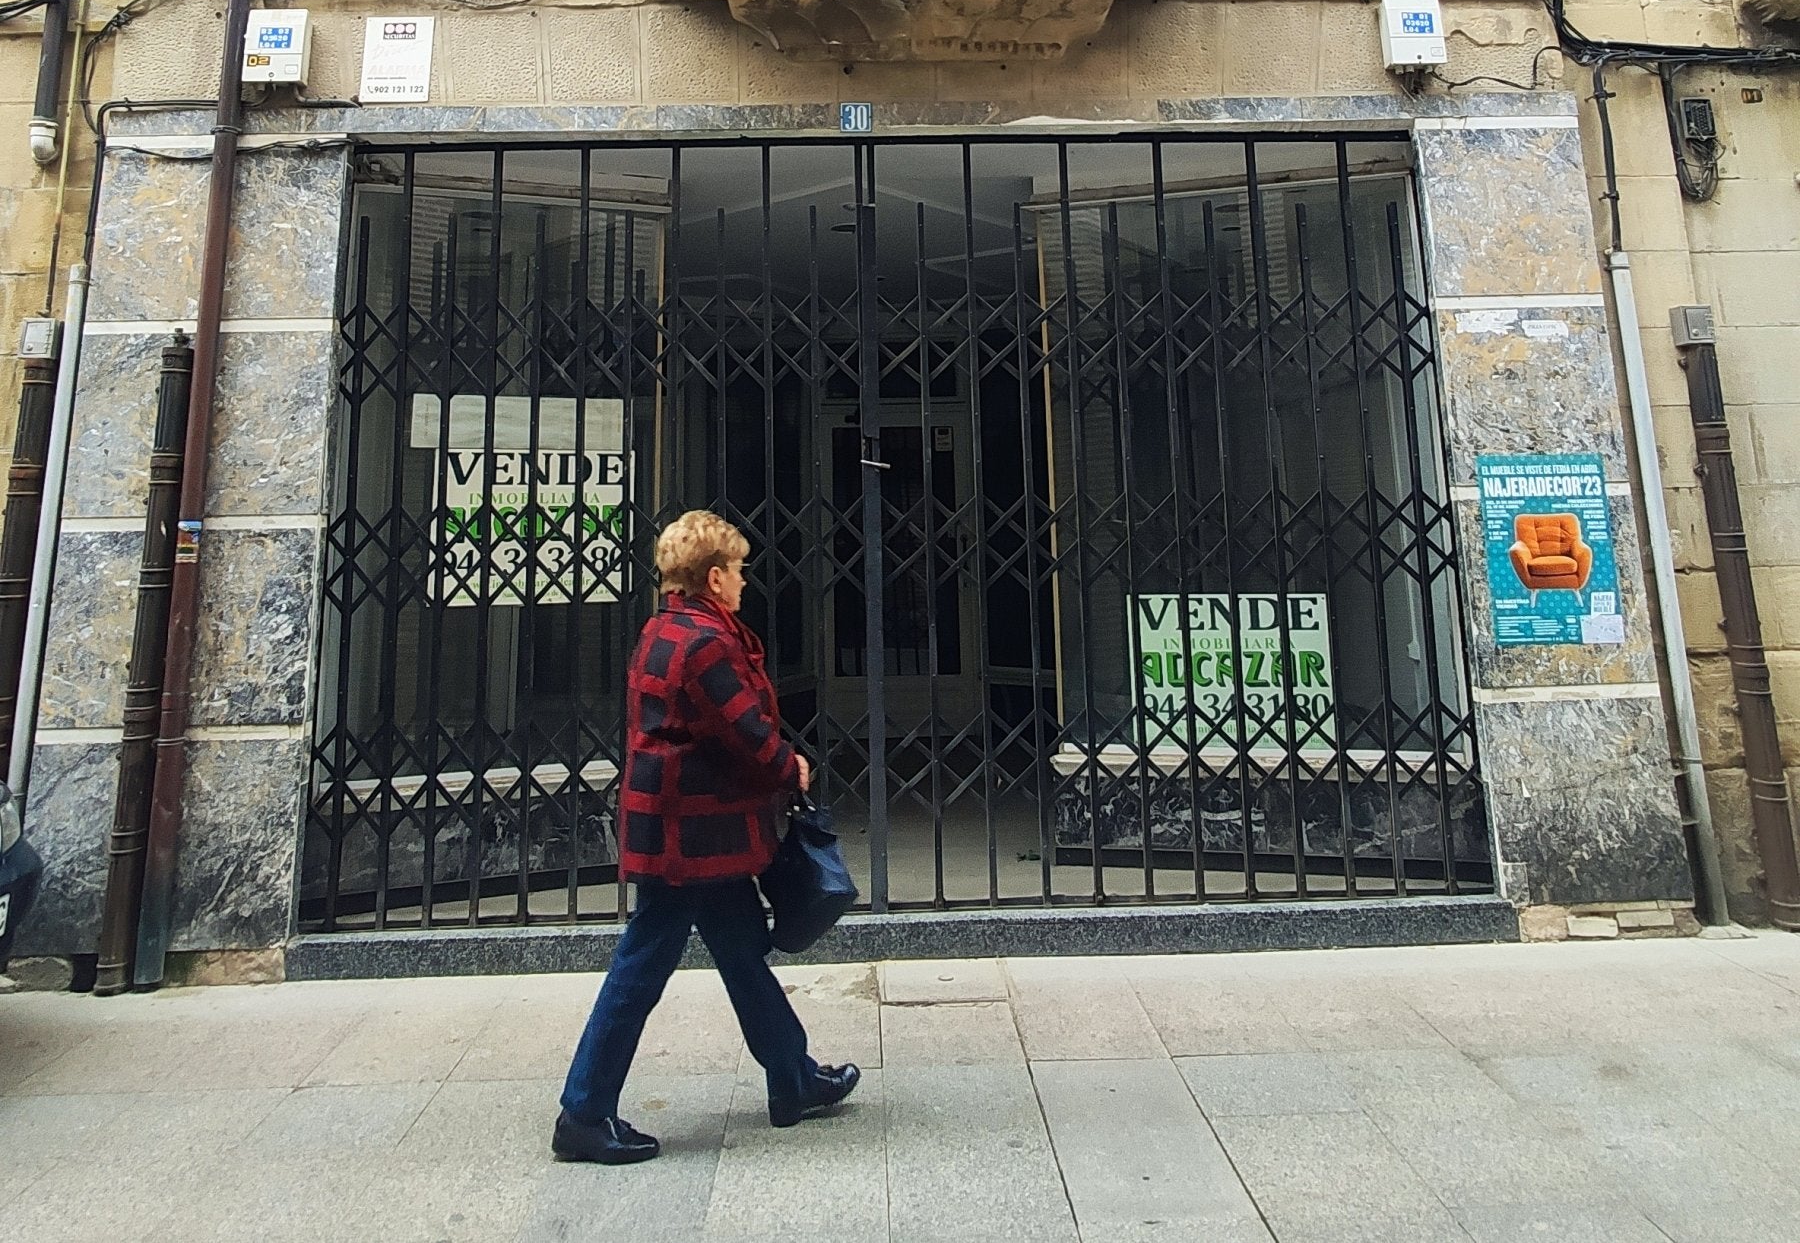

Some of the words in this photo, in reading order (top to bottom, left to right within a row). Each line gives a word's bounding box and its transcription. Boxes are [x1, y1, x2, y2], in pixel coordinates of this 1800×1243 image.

[374, 85, 389, 94] 902
[392, 85, 406, 94] 121
[409, 85, 424, 93] 122
[844, 105, 868, 130] 30
[447, 452, 626, 486] VENDE
[1481, 465, 1490, 475] EL
[1490, 465, 1516, 475] MUEBLE
[1516, 465, 1525, 475] SE
[1525, 465, 1543, 474] VISTE
[1543, 465, 1553, 474] DE
[1553, 464, 1571, 474] FERIA
[1571, 464, 1580, 474] EN
[1138, 597, 1320, 631] VENDE
